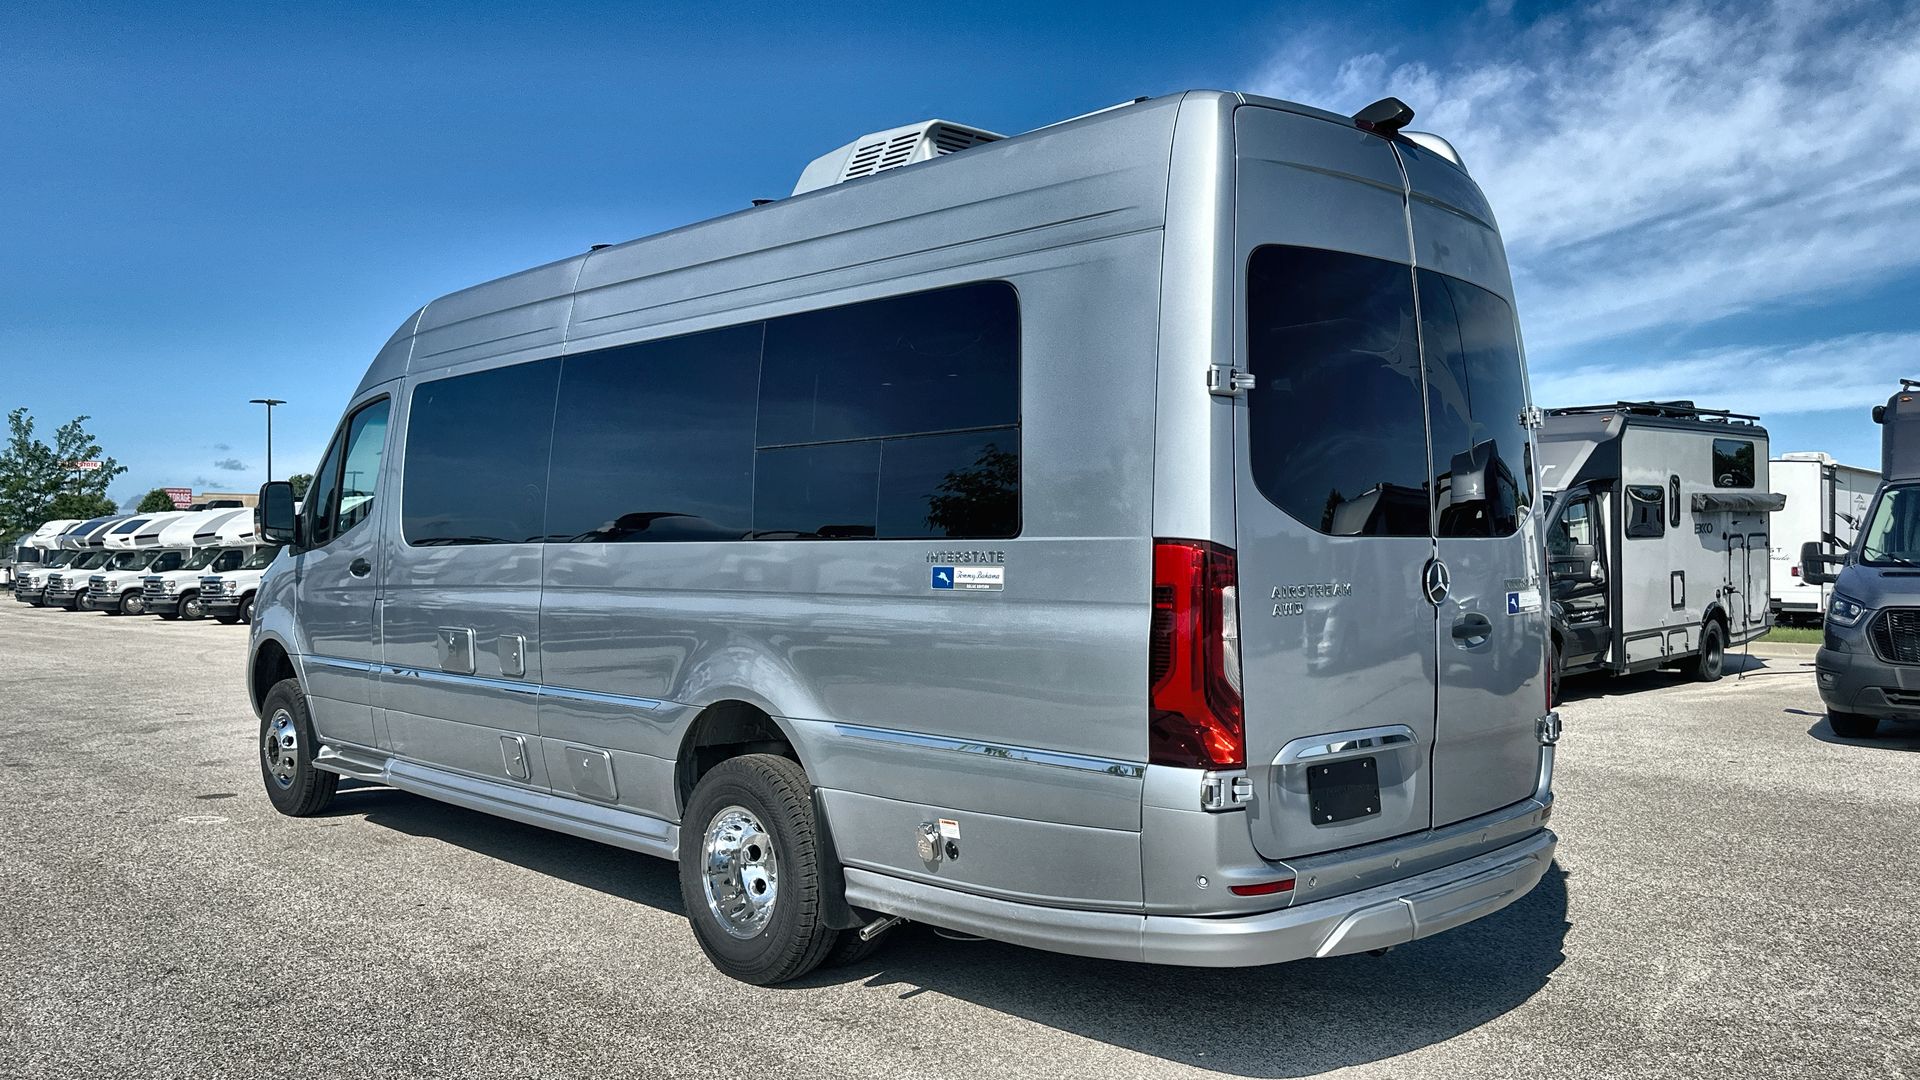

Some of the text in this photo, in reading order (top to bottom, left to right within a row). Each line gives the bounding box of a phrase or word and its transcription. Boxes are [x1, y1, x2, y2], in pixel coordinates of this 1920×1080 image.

[926, 550, 1005, 562] INTERSTATE
[956, 570, 1001, 581] Tommy Bahama
[1271, 582, 1352, 599] AIRSTREAM
[1271, 601, 1304, 616] AWD
